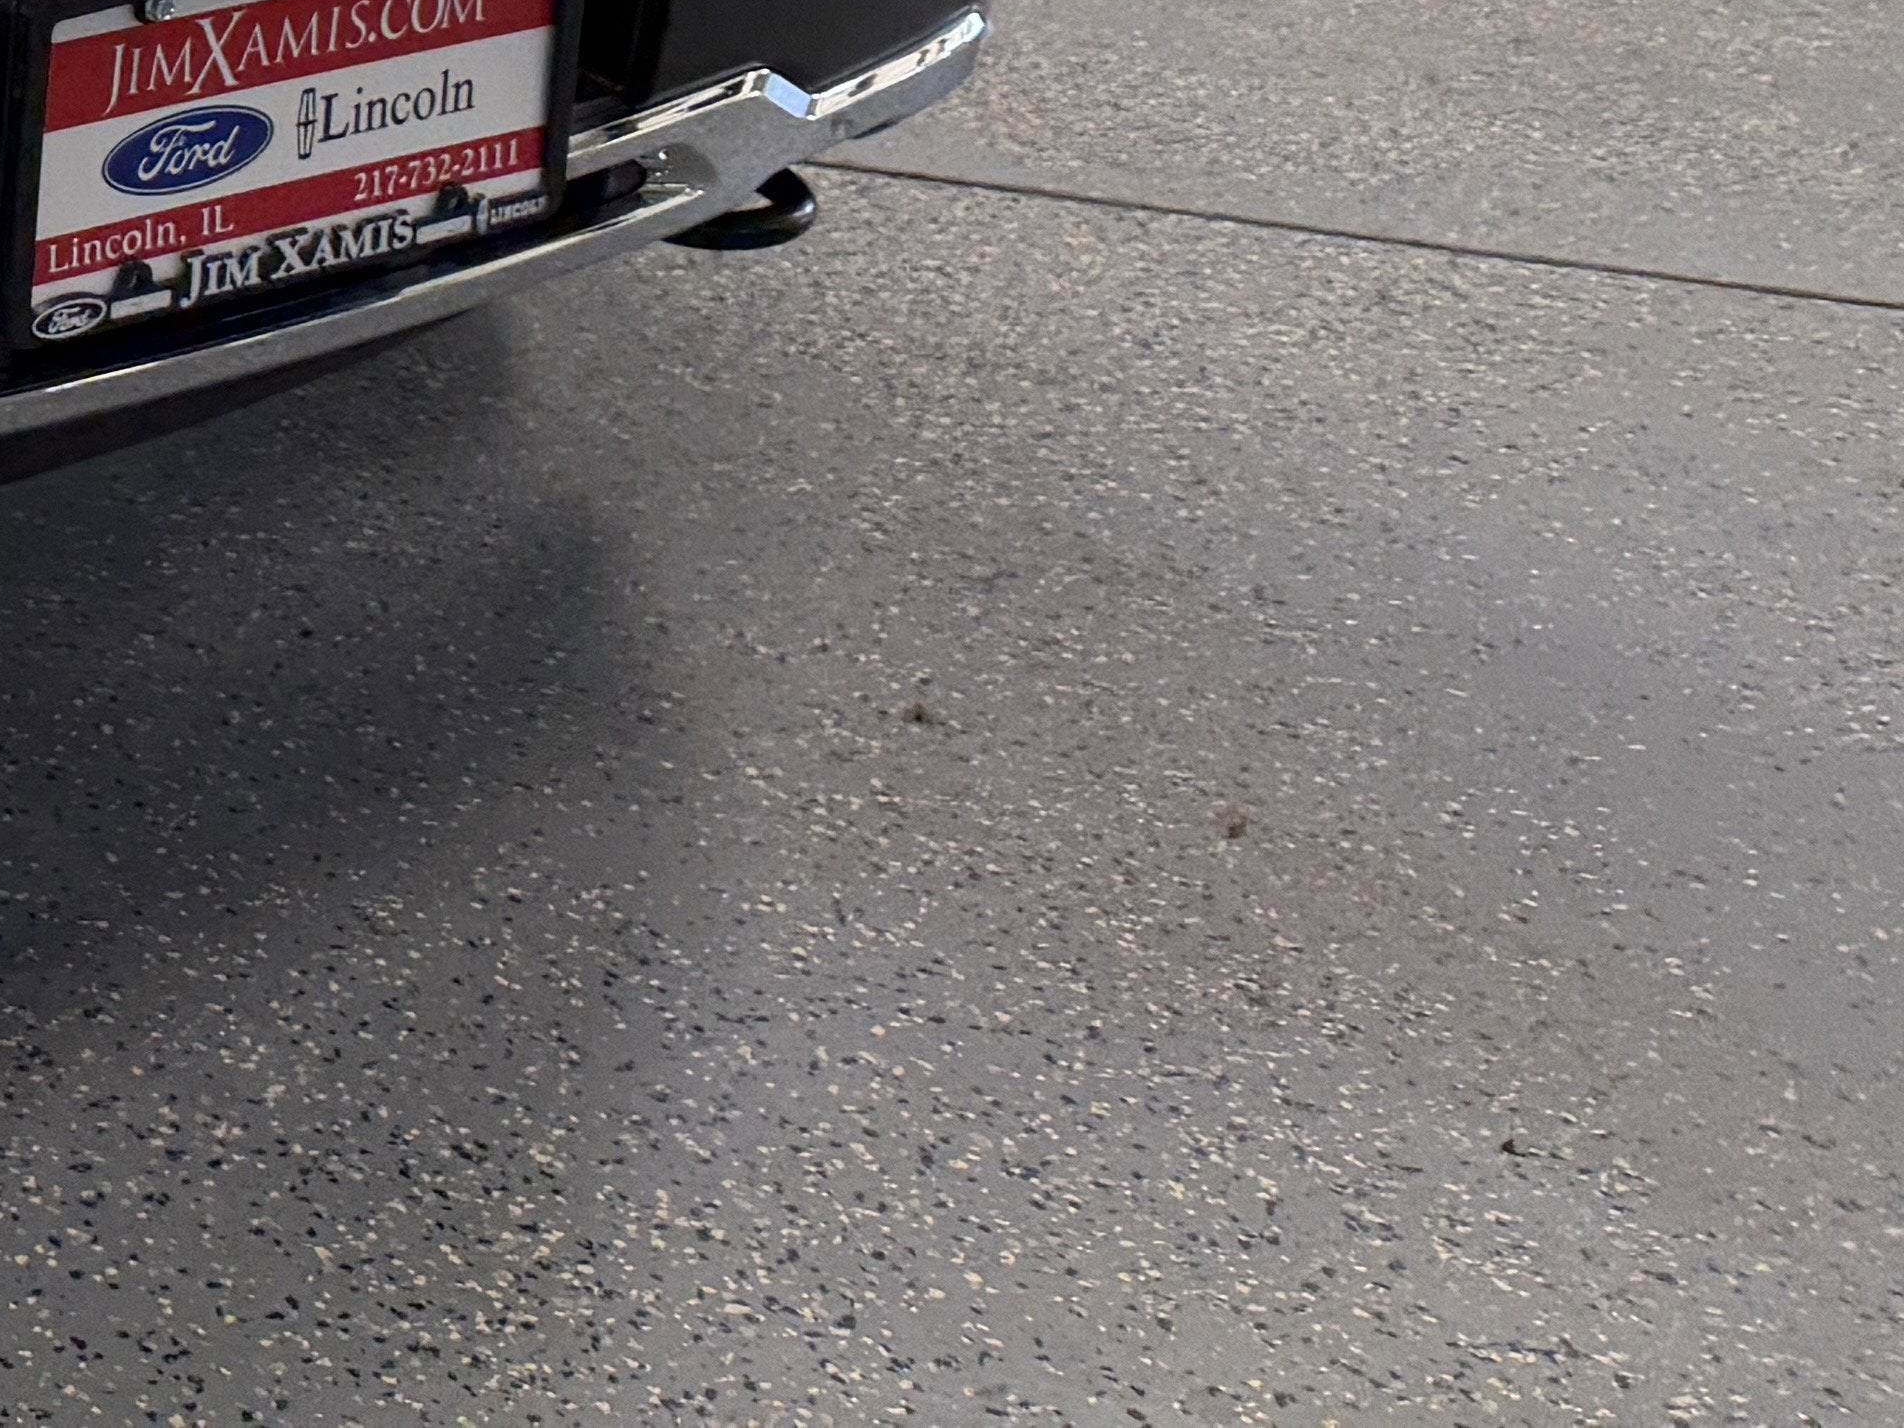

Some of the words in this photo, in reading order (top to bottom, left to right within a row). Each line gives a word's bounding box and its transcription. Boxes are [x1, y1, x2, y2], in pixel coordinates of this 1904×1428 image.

[317, 69, 476, 142] Lincoln
[137, 120, 240, 181] Ford
[354, 139, 518, 201] 217-732-2111
[48, 219, 187, 273] Lincoln,
[201, 205, 234, 236] IL
[179, 246, 262, 309] JIM
[269, 215, 415, 279] XAMIS
